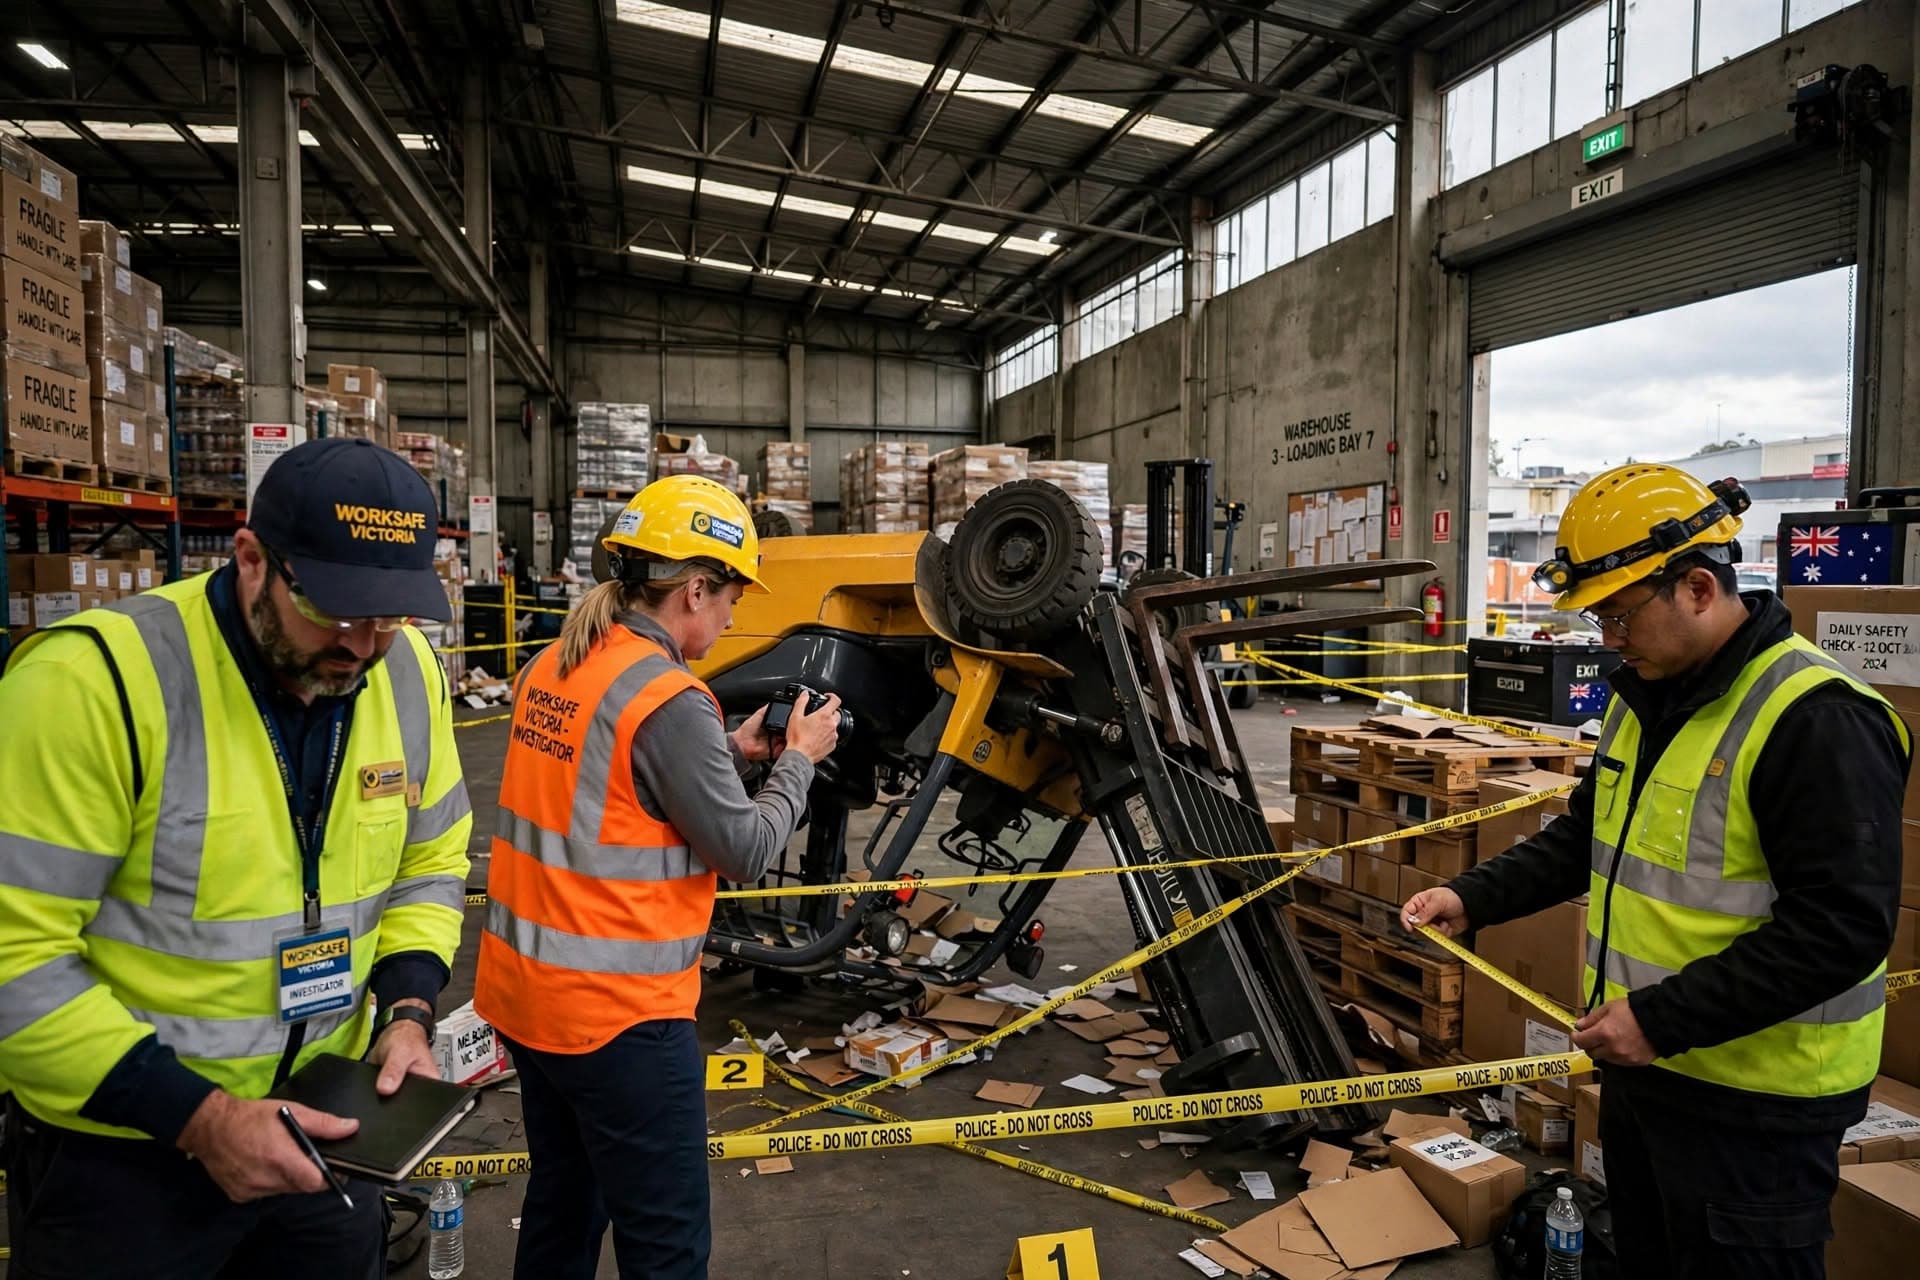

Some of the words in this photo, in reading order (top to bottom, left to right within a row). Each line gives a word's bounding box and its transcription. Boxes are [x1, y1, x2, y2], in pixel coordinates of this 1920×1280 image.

[1590, 131, 1618, 155] EXIT
[1579, 175, 1614, 203] EXIT
[20, 198, 66, 243] FRAGILE
[22, 277, 70, 319] FRAGILE
[24, 375, 77, 413] FRAGILE
[20, 411, 51, 432] HANDLE
[71, 420, 89, 441] CARE
[1284, 412, 1351, 442] WAREHOUSE
[1272, 448, 1279, 465] 3
[1287, 438, 1336, 462] LOADING
[1339, 432, 1362, 453] BAY
[1366, 430, 1375, 450] 7
[335, 503, 426, 530] WORKSAFE
[350, 523, 416, 544] VICTORIA
[1829, 623, 1862, 636] DAILY
[1865, 625, 1908, 638] SAFETY
[1821, 639, 1855, 651] CHECK
[1864, 642, 1875, 653] 12
[1878, 642, 1901, 654] OCT
[1576, 664, 1599, 678] EXIT
[1862, 658, 1887, 671] 2024
[526, 686, 580, 719] WORKSAFE
[525, 706, 562, 735] VICTORIA
[513, 723, 575, 763] INVESTIGATOR
[286, 940, 345, 963] WORKSAFE
[722, 1059, 747, 1083] 2
[1456, 1069, 1491, 1087] POLICE
[1499, 1066, 1514, 1082] DO
[1516, 1063, 1534, 1080] NOT
[1538, 1059, 1570, 1077] CROSS
[1300, 1086, 1338, 1105] POLICE
[1347, 1083, 1362, 1099] DO
[1365, 1081, 1384, 1098] NOT
[1388, 1077, 1422, 1094] CROSS
[1132, 1103, 1173, 1122] POLICE
[1182, 1100, 1198, 1118] DO
[1202, 1098, 1223, 1115] NOT
[1226, 1094, 1263, 1112] CROSS
[955, 1120, 997, 1139] POLICE
[1007, 1117, 1024, 1134] DO
[1028, 1115, 1050, 1132] NOT
[1054, 1111, 1093, 1130] CROSS
[768, 1135, 812, 1153] POLICE
[823, 1133, 841, 1150] DO
[844, 1131, 868, 1149] NOT
[871, 1126, 912, 1146] CROSS
[412, 1161, 443, 1177] LICE
[455, 1160, 473, 1176] DO
[477, 1158, 505, 1174] NOT
[1047, 1243, 1070, 1280] 1
